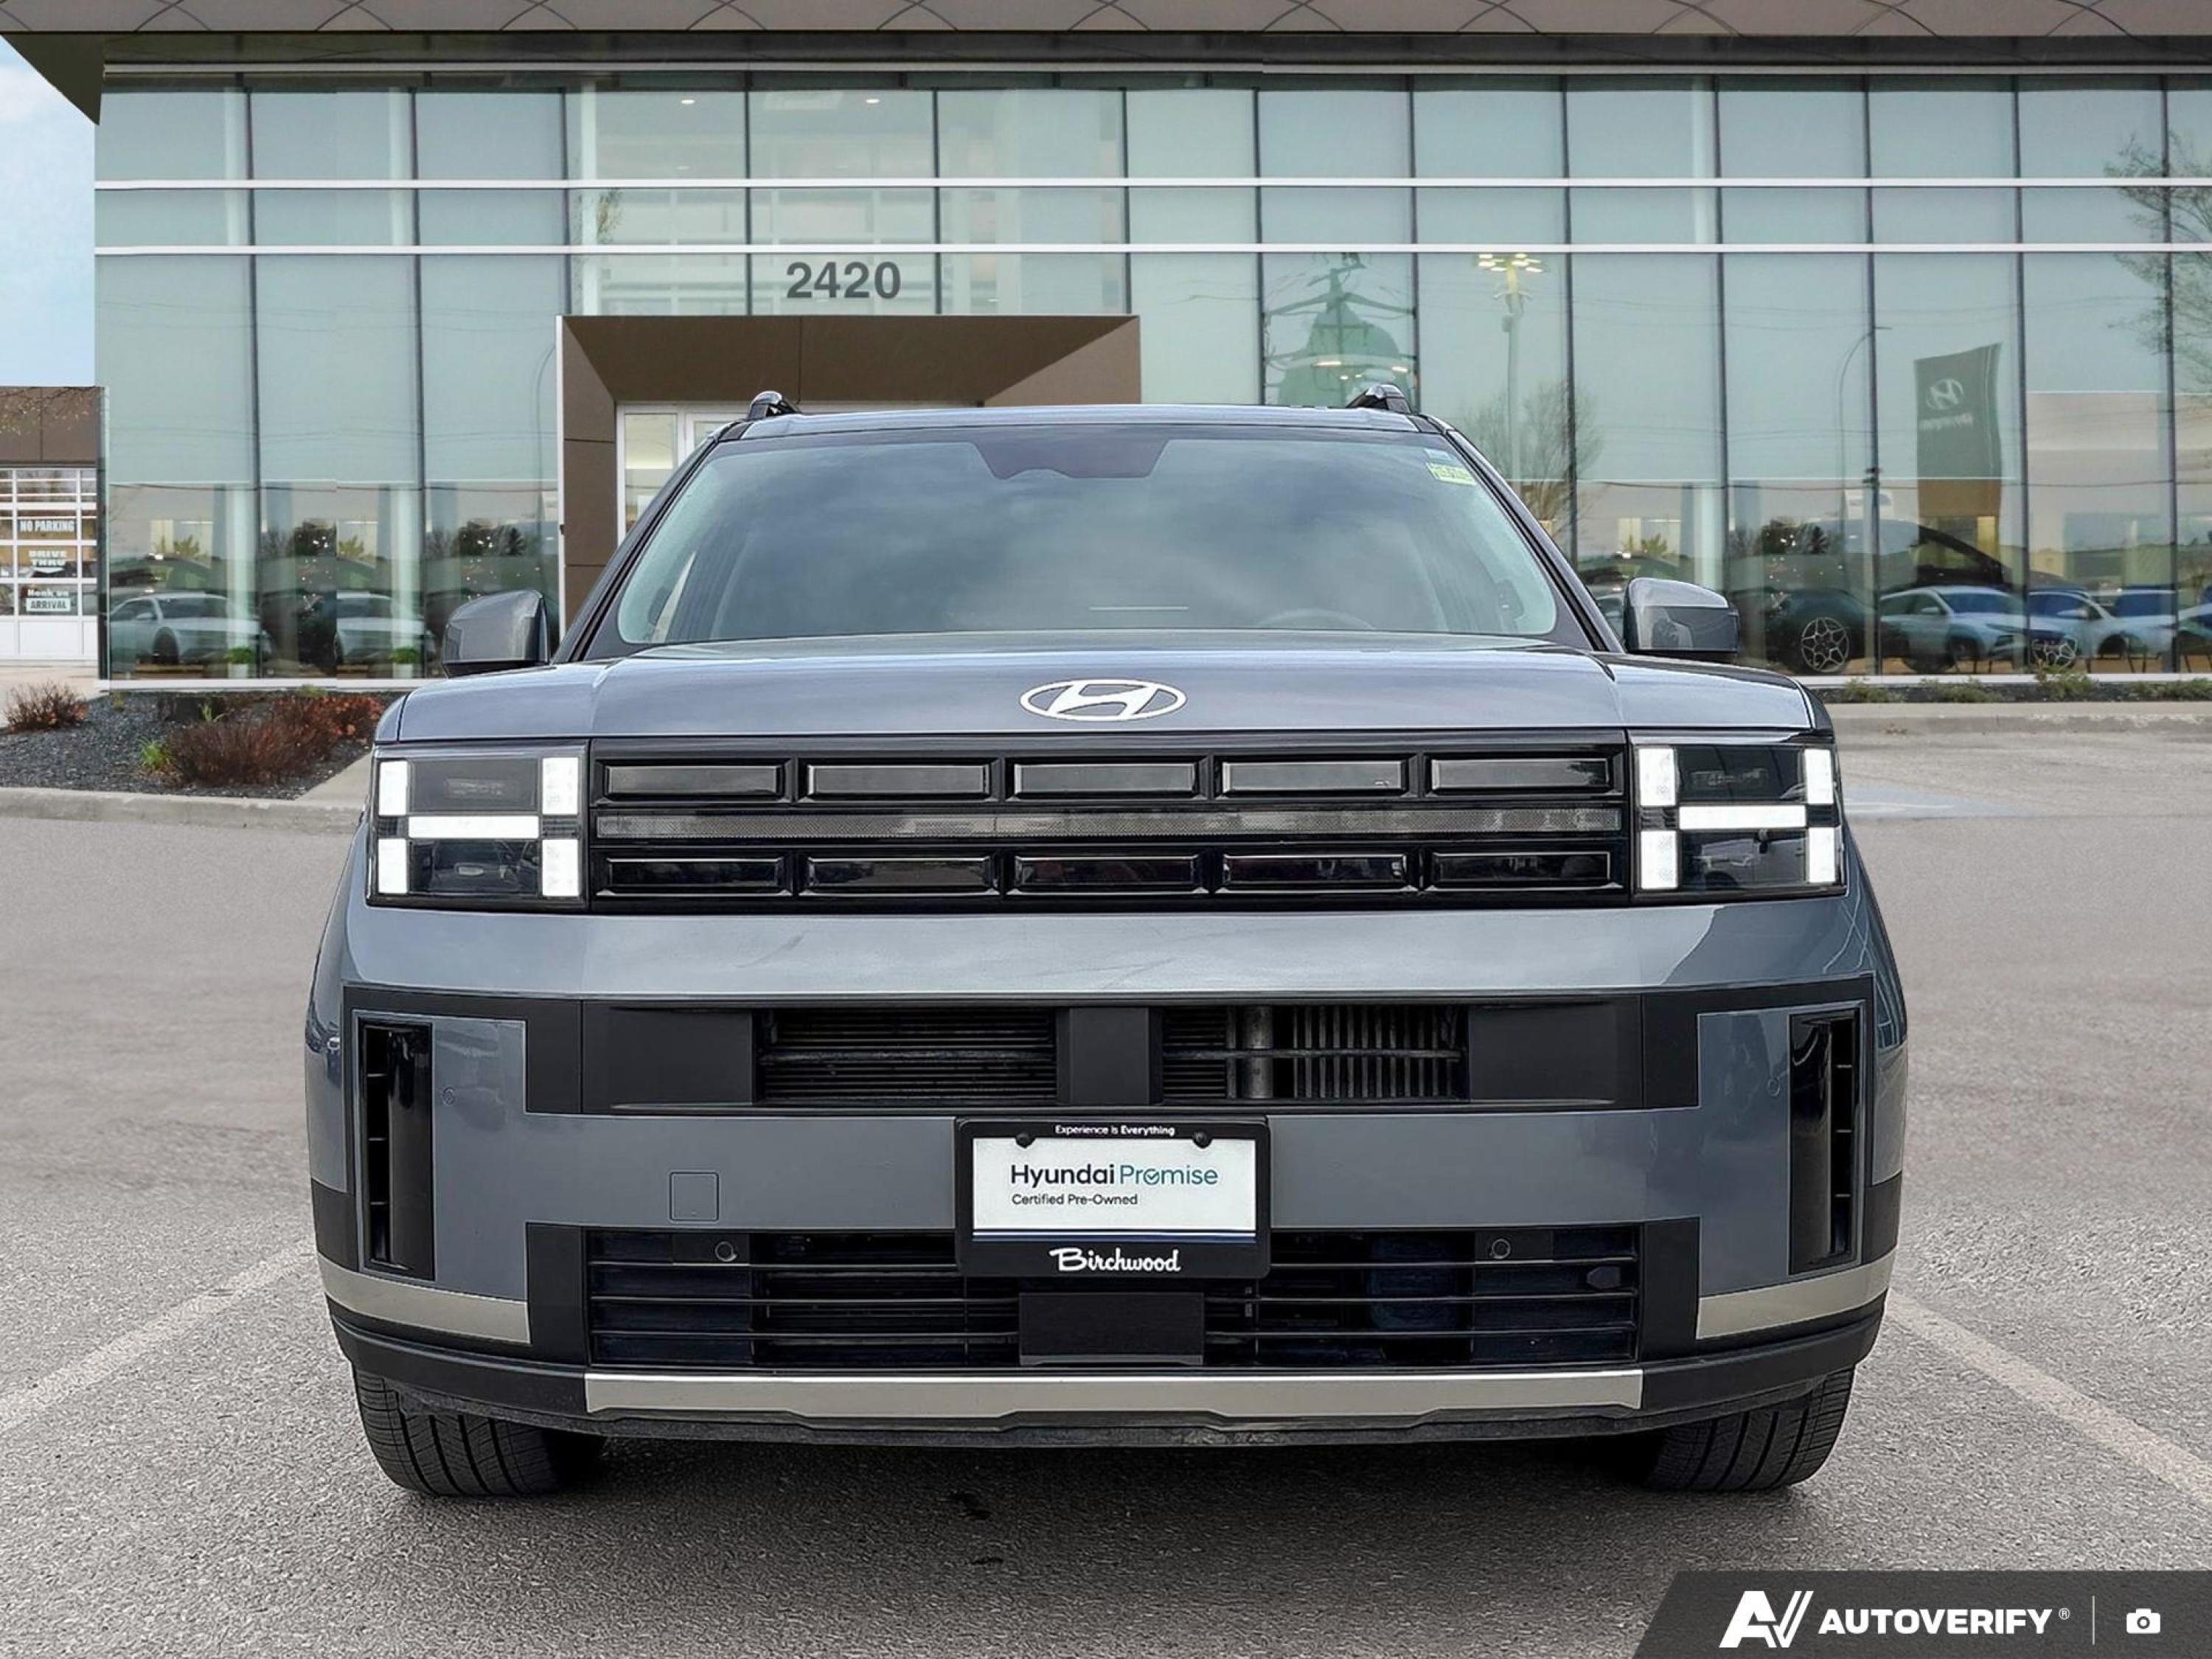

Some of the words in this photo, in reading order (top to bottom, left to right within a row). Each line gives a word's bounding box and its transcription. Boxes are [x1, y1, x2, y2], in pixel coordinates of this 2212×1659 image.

[786, 261, 901, 299] 2420
[20, 520, 33, 532] NO
[34, 520, 74, 532] PARKING
[30, 599, 67, 609] ARRIVAL
[1055, 1124, 1109, 1135] Experience
[1111, 1125, 1119, 1135] is
[1121, 1125, 1175, 1136] Everything
[1011, 1164, 1114, 1188] Hyundai
[1120, 1165, 1218, 1185] Promise
[1012, 1194, 1064, 1205] Certified
[1068, 1194, 1138, 1205] Pre-Owned
[1049, 1247, 1180, 1272] Birchwood
